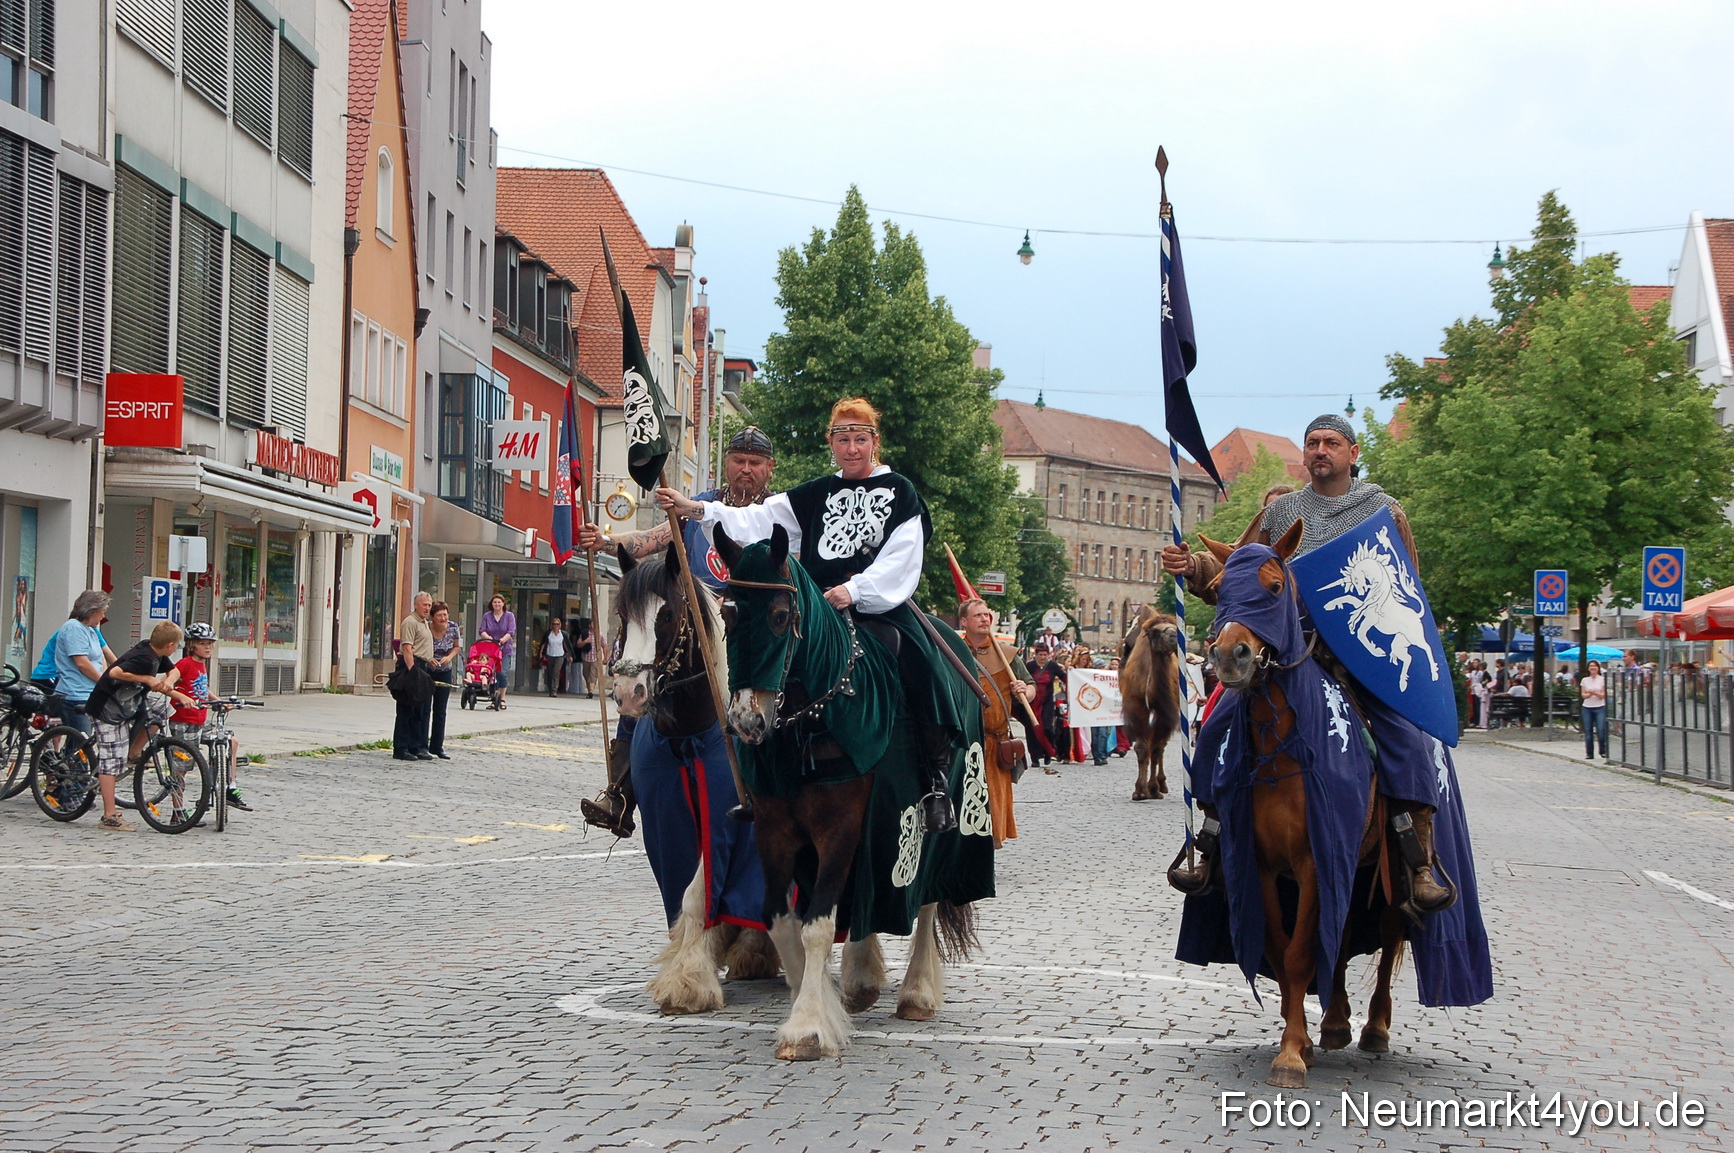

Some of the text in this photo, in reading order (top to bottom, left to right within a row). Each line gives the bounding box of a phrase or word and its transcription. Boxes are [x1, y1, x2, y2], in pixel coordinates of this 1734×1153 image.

[107, 401, 174, 419] ESPRIT
[498, 431, 540, 460] H&M
[154, 585, 167, 603] P
[1645, 592, 1680, 607] TAXI
[1537, 601, 1565, 612] TAXI
